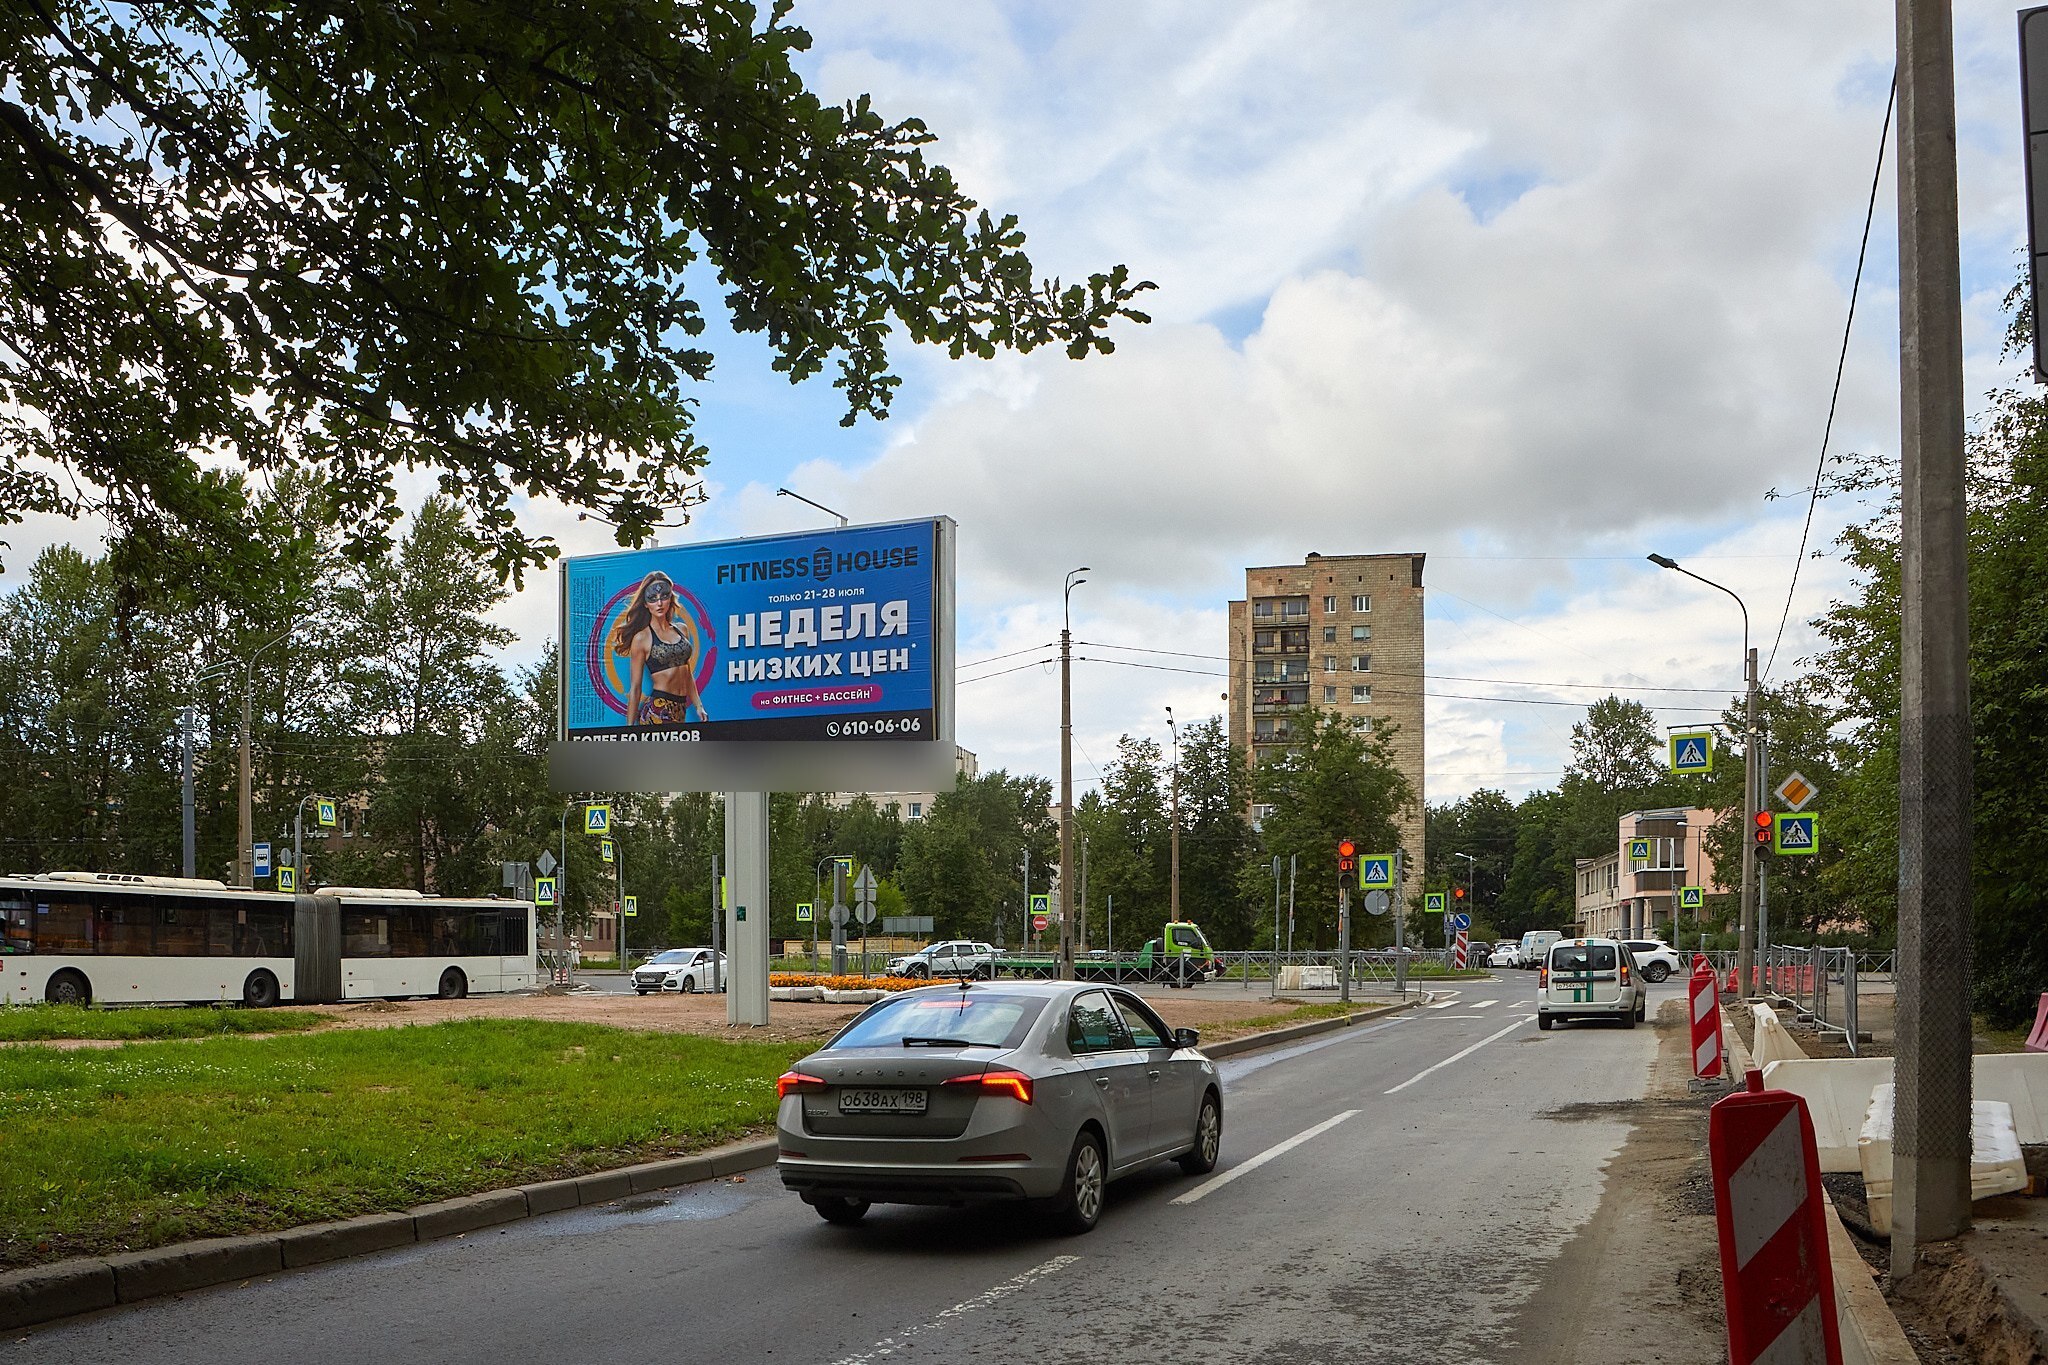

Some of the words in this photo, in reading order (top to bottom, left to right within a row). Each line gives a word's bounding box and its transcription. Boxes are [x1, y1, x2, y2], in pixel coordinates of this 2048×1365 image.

[717, 557, 809, 584] FITNESS
[837, 546, 918, 572] HOUSE
[728, 600, 908, 649] НЕДЕЛЯ
[728, 653, 843, 683] НИЗКИХ
[760, 698, 770, 706] на
[772, 692, 813, 705] ФИТНЕС
[1340, 861, 1353, 870] 07
[902, 1092, 922, 1103] 198
